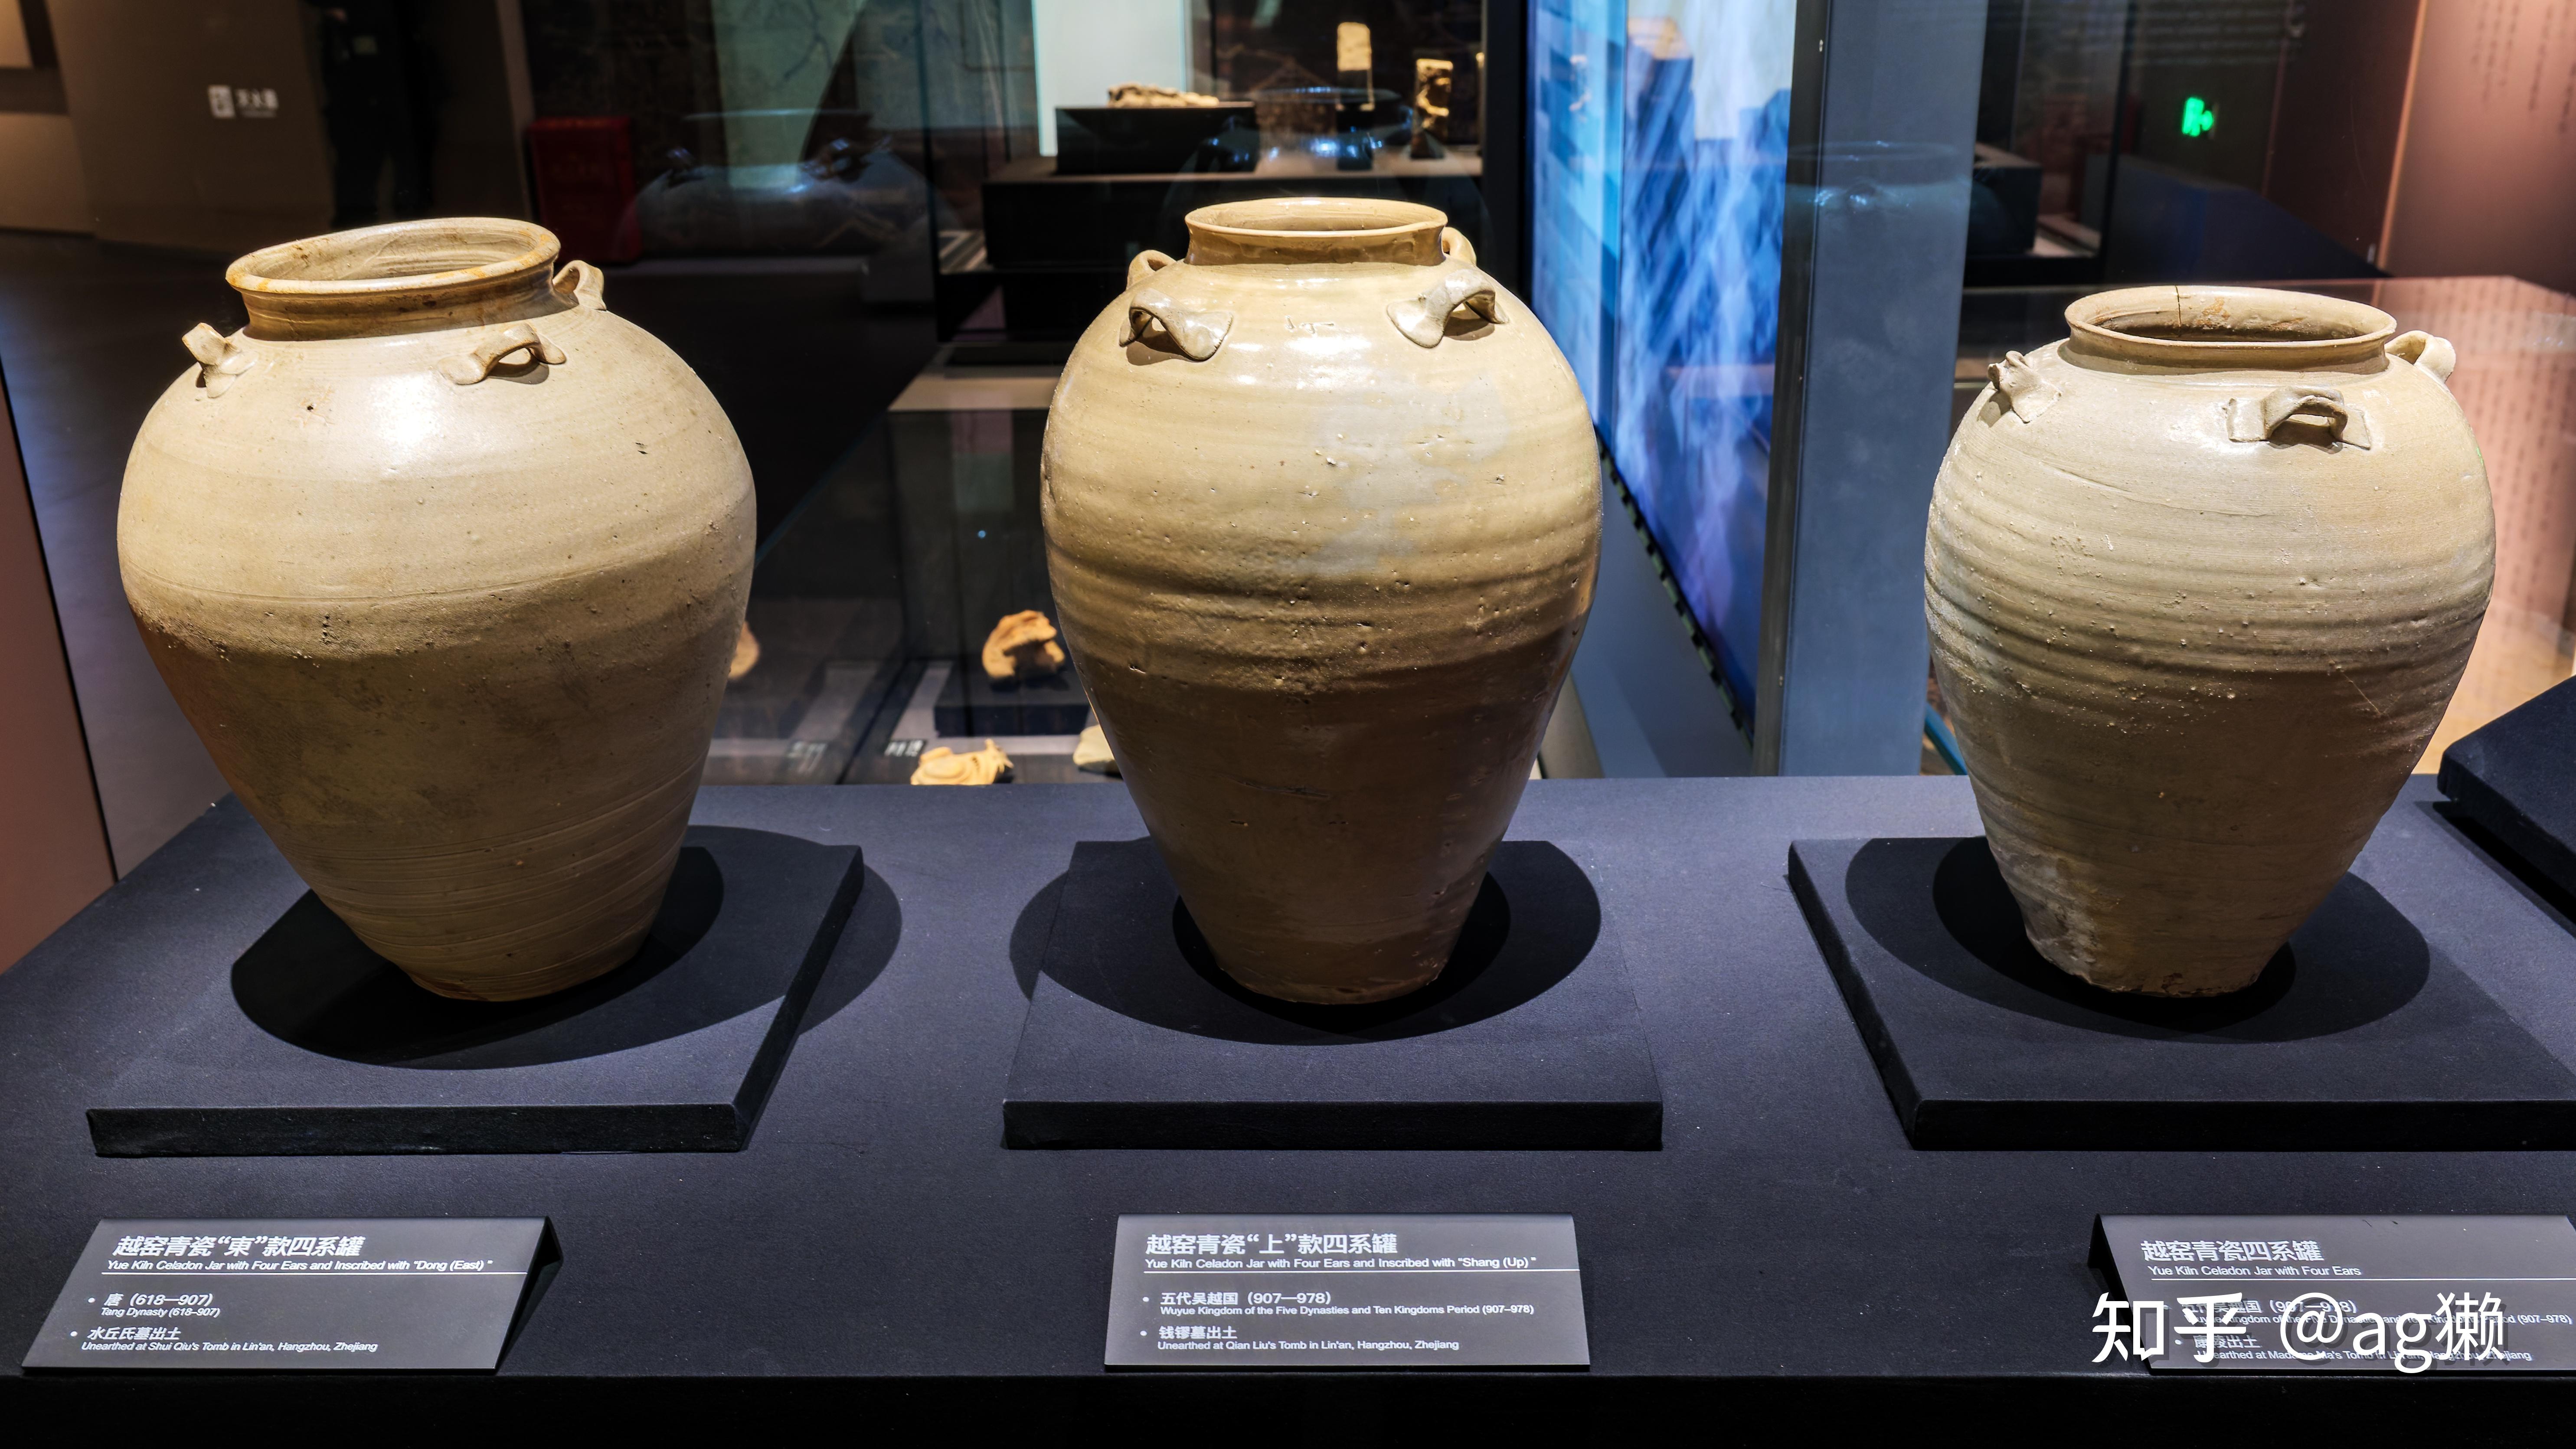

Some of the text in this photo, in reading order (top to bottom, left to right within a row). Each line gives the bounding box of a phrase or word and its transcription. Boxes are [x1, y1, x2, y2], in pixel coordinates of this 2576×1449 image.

[2140, 1240, 2325, 1262] 越窑青瓷四系罐
[108, 1260, 129, 1270] Yue
[131, 1260, 154, 1270] Kiln
[156, 1260, 203, 1270] Celadon
[205, 1260, 225, 1270] Jar
[226, 1260, 249, 1270] with
[251, 1260, 279, 1270] Four
[280, 1260, 307, 1270] Ears
[309, 1260, 333, 1270] and
[334, 1260, 386, 1270] Inscribed
[387, 1260, 410, 1270] with
[1145, 1259, 1168, 1268] Yue
[1171, 1259, 1193, 1268] Kiln
[1196, 1259, 1243, 1268] Celadon
[1246, 1259, 1265, 1268] Jar
[1267, 1259, 1291, 1268] with
[1294, 1259, 1321, 1268] Four
[1324, 1259, 1351, 1268] Ears
[1353, 1259, 1375, 1268] and
[1378, 1258, 1429, 1268] Inscribed
[1431, 1258, 1456, 1267] with
[1503, 1257, 1529, 1269] (Up)
[2147, 1266, 2362, 1276] Yue Kiln Celadon Jar with Four Ears
[101, 1307, 125, 1318] Tang
[126, 1307, 168, 1318] Dynasty
[1160, 1306, 1196, 1316] Wuyue
[1197, 1306, 1243, 1316] Kingdom
[1244, 1306, 1255, 1315] of
[1257, 1306, 1274, 1315] the
[1275, 1306, 1298, 1315] Five
[1300, 1306, 1350, 1316] Dynasties
[1351, 1306, 1371, 1314] and
[1373, 1305, 1392, 1314] Ten
[1394, 1305, 1445, 1316] Kingdoms
[1446, 1305, 1480, 1314] Period
[87, 1326, 181, 1340] 水丘氏墓出土
[1158, 1325, 1238, 1340] 钱镠墓出土
[82, 1342, 135, 1351] Unearthed
[136, 1342, 147, 1351] at
[148, 1342, 173, 1351] Shui
[173, 1342, 199, 1351] Qiu's
[202, 1342, 229, 1351] Tomb
[230, 1342, 242, 1351] in
[277, 1342, 331, 1353] Hangzhou,
[333, 1342, 379, 1353] Zhejiang
[1157, 1341, 1460, 1351] Unearthed at Qian Liu's Tomb in Lin'an, Hangzhou, Zhejiang
[2255, 1351, 2267, 1359] at
